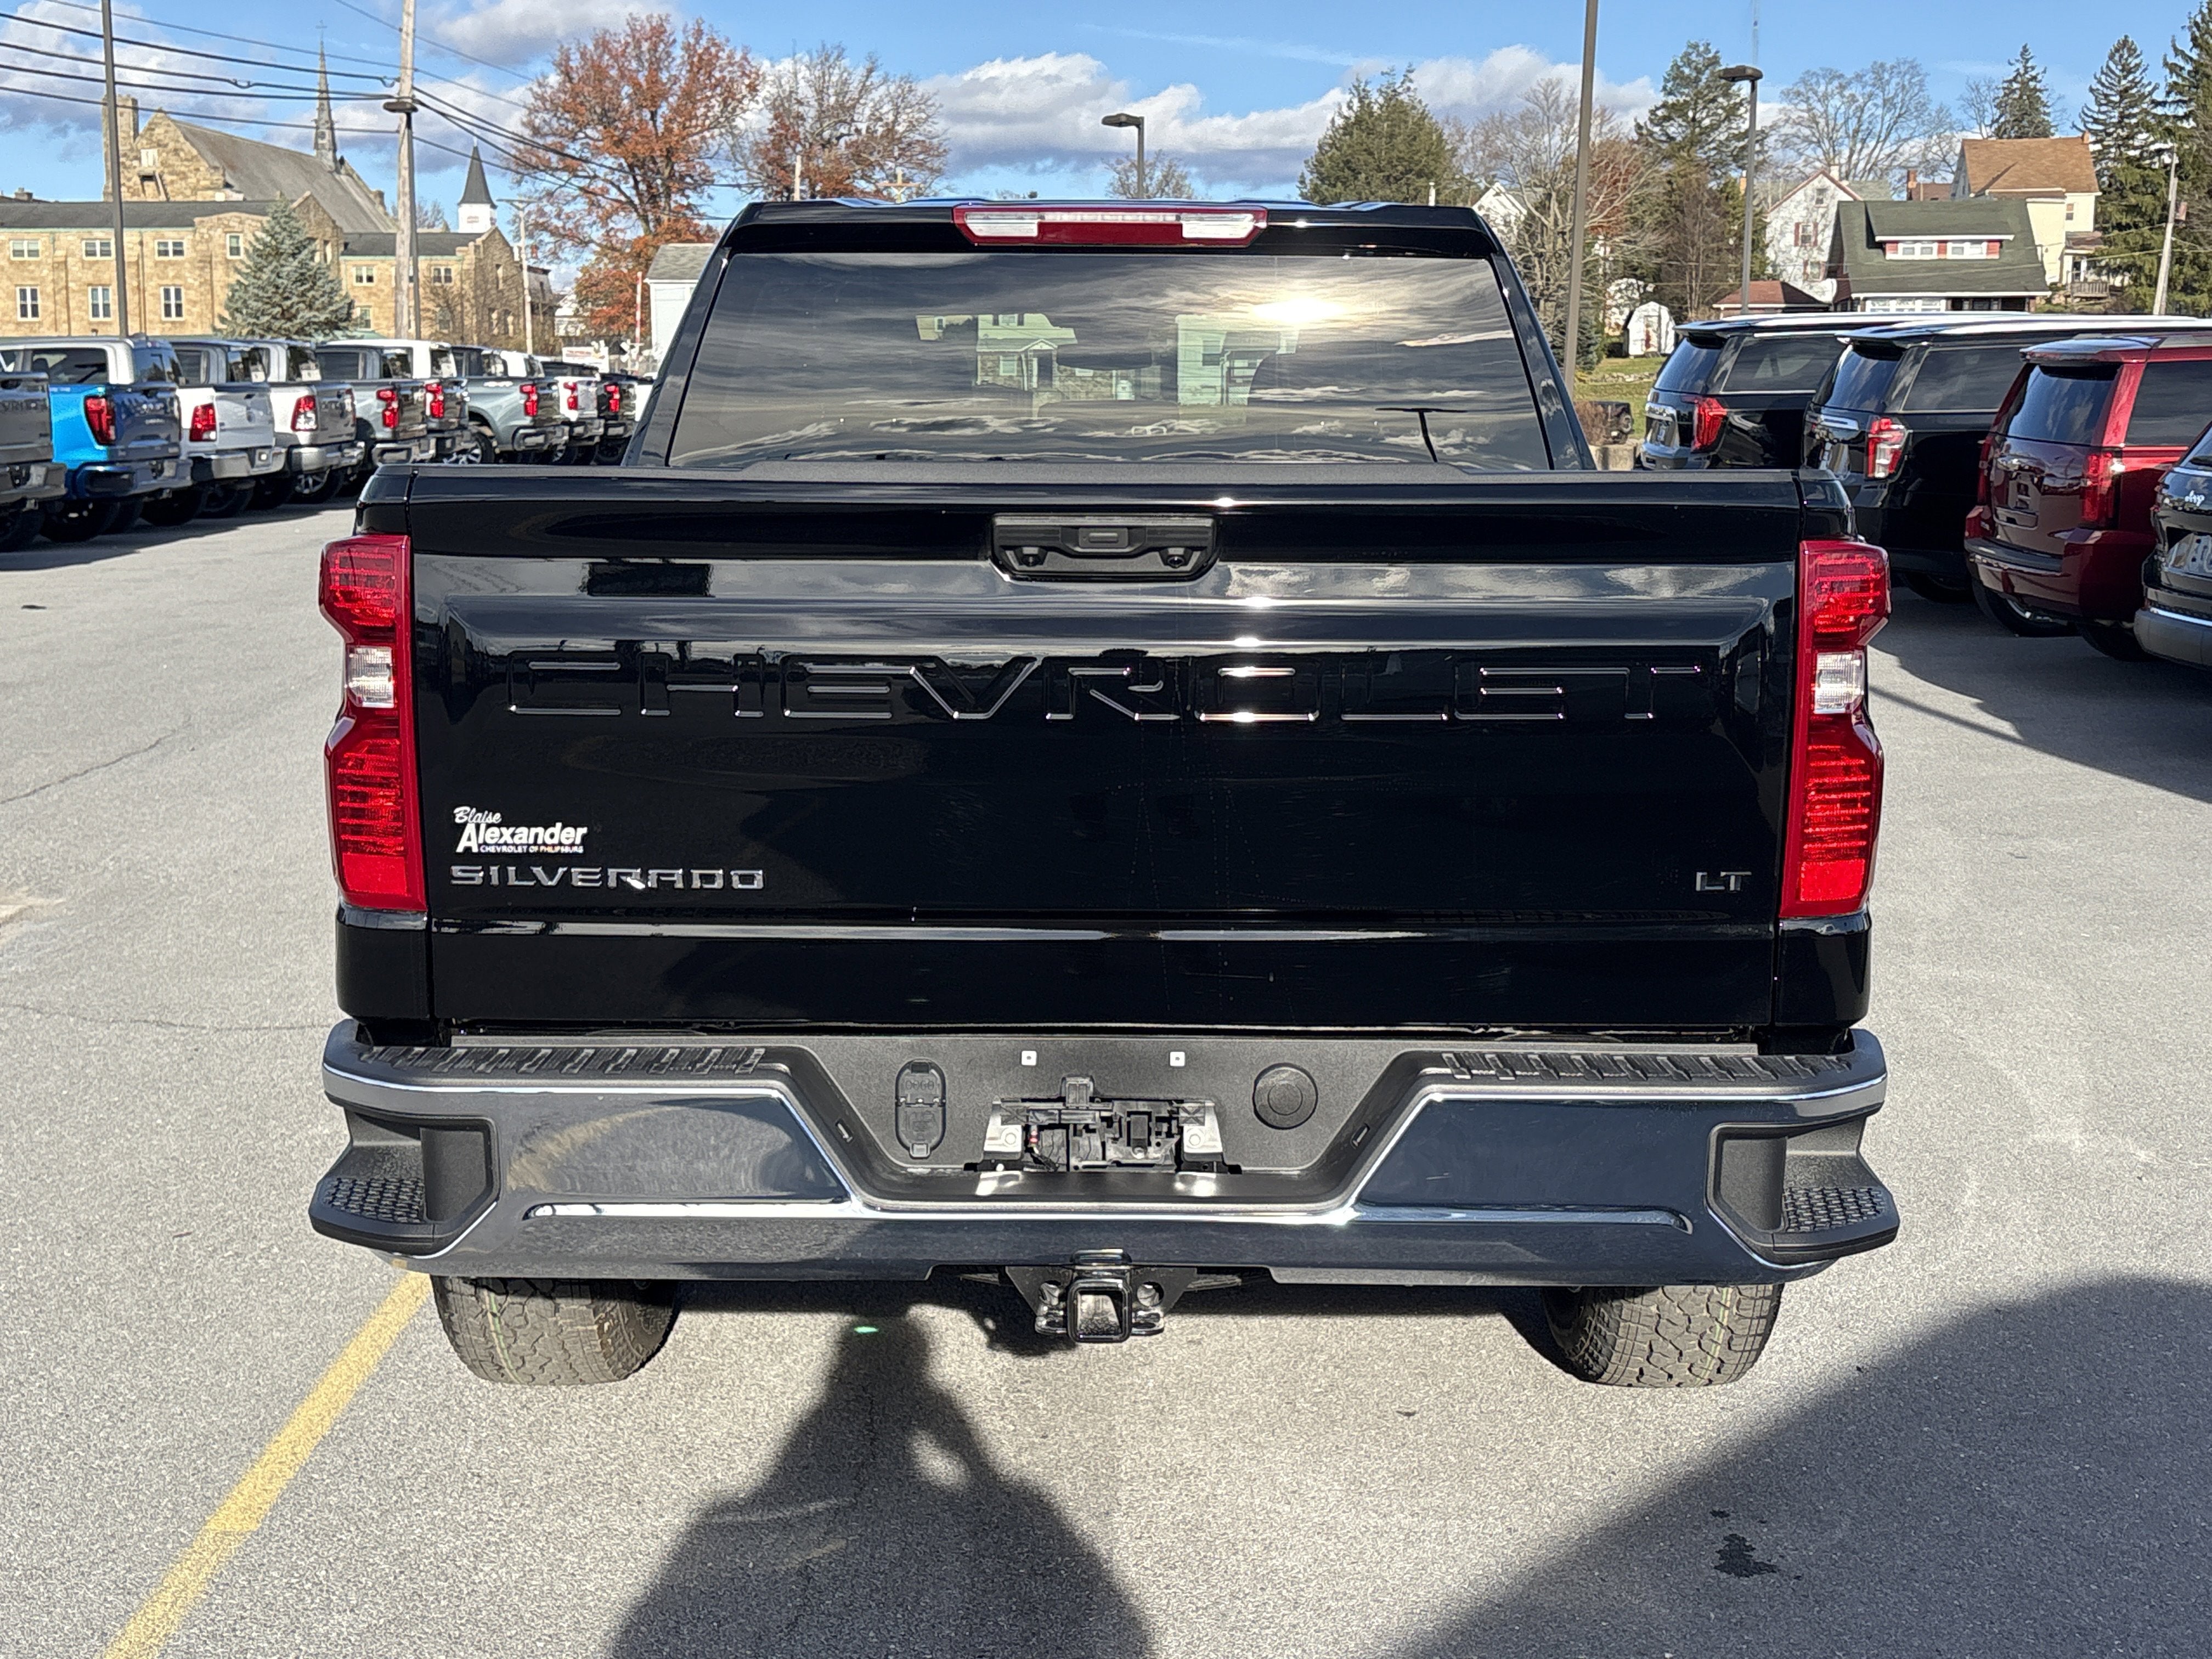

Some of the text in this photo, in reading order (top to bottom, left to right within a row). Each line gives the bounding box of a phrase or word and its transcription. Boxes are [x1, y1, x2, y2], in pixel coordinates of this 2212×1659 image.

[505, 650, 1702, 721] CHEVROLET
[453, 806, 502, 823] Blaise
[455, 822, 588, 853] Alexander
[450, 865, 764, 890] SILVERADO
[1696, 871, 1752, 891] LT
